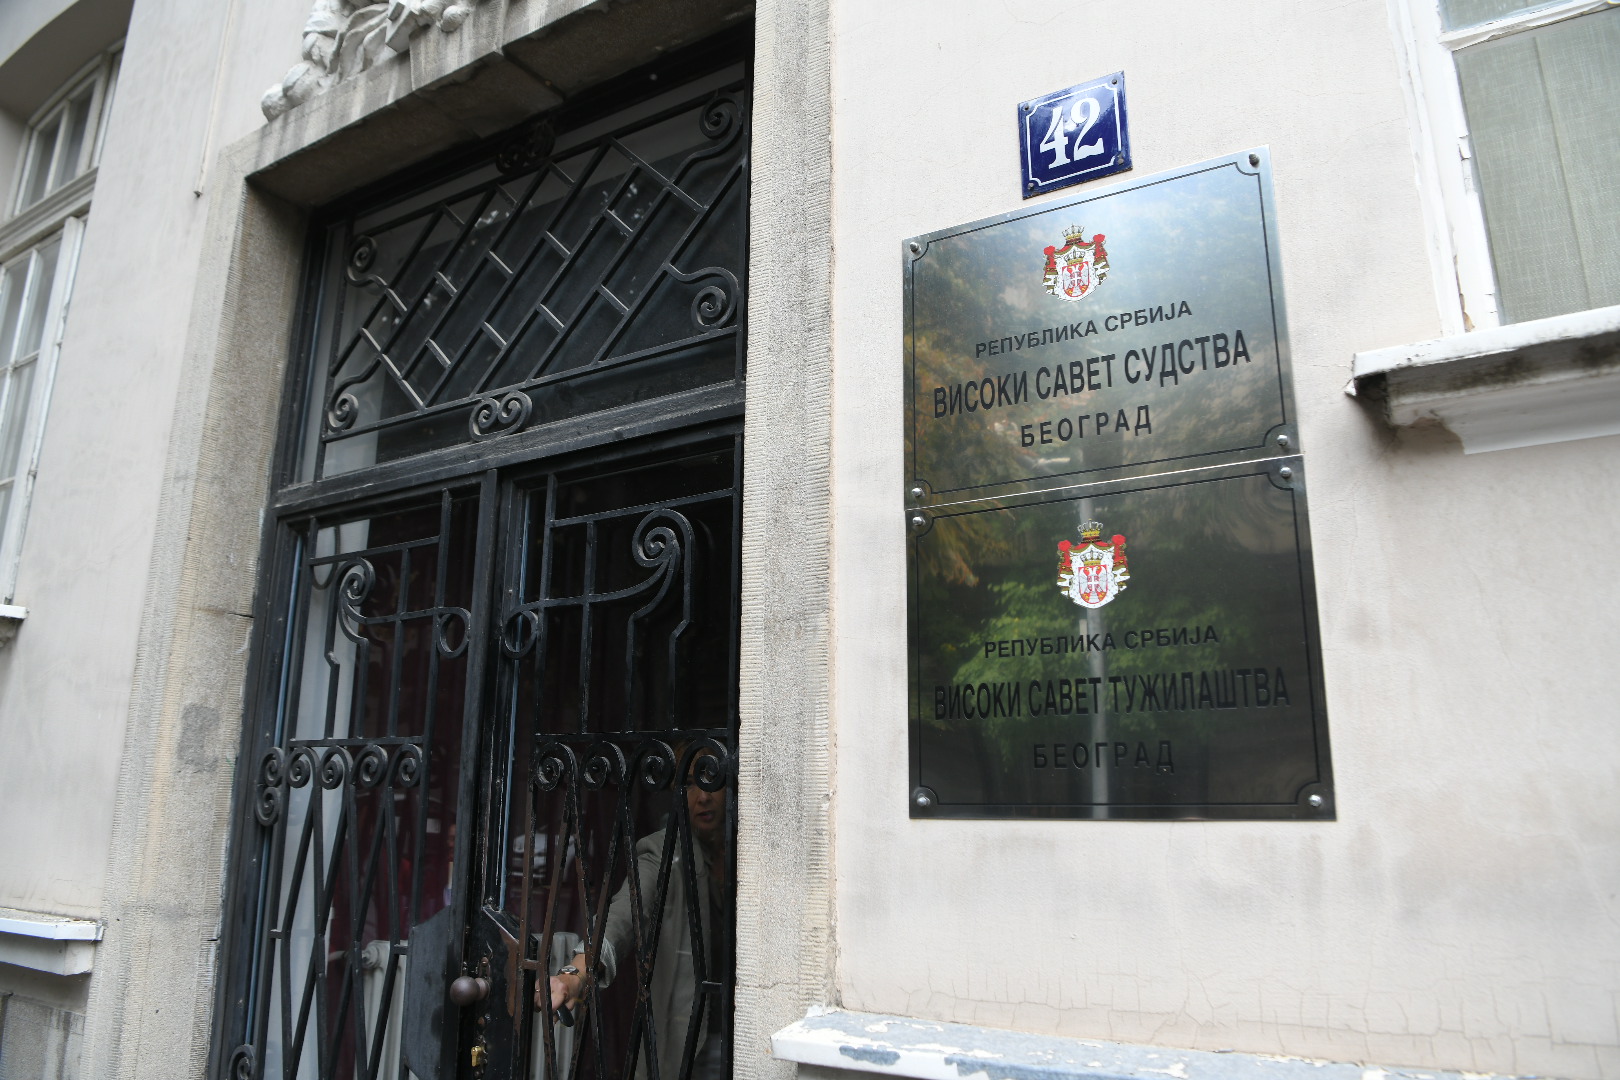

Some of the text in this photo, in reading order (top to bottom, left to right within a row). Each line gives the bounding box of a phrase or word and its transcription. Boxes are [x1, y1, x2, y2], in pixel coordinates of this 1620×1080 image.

[1040, 98, 1104, 169] 42
[976, 300, 1192, 358] РЕПУБЛИКА СРБИЈА
[934, 330, 1251, 418] ВИСОКИ САВЕТ СУДСТВА
[1021, 405, 1152, 447] БЕОГРАД
[984, 625, 1219, 659] РЕПУБЛИКА СРБИЈА
[935, 667, 1291, 720] ВИСОКИ САВЕТ ТУЖИЛАШТВА
[1033, 740, 1174, 774] БЕОГРАД
